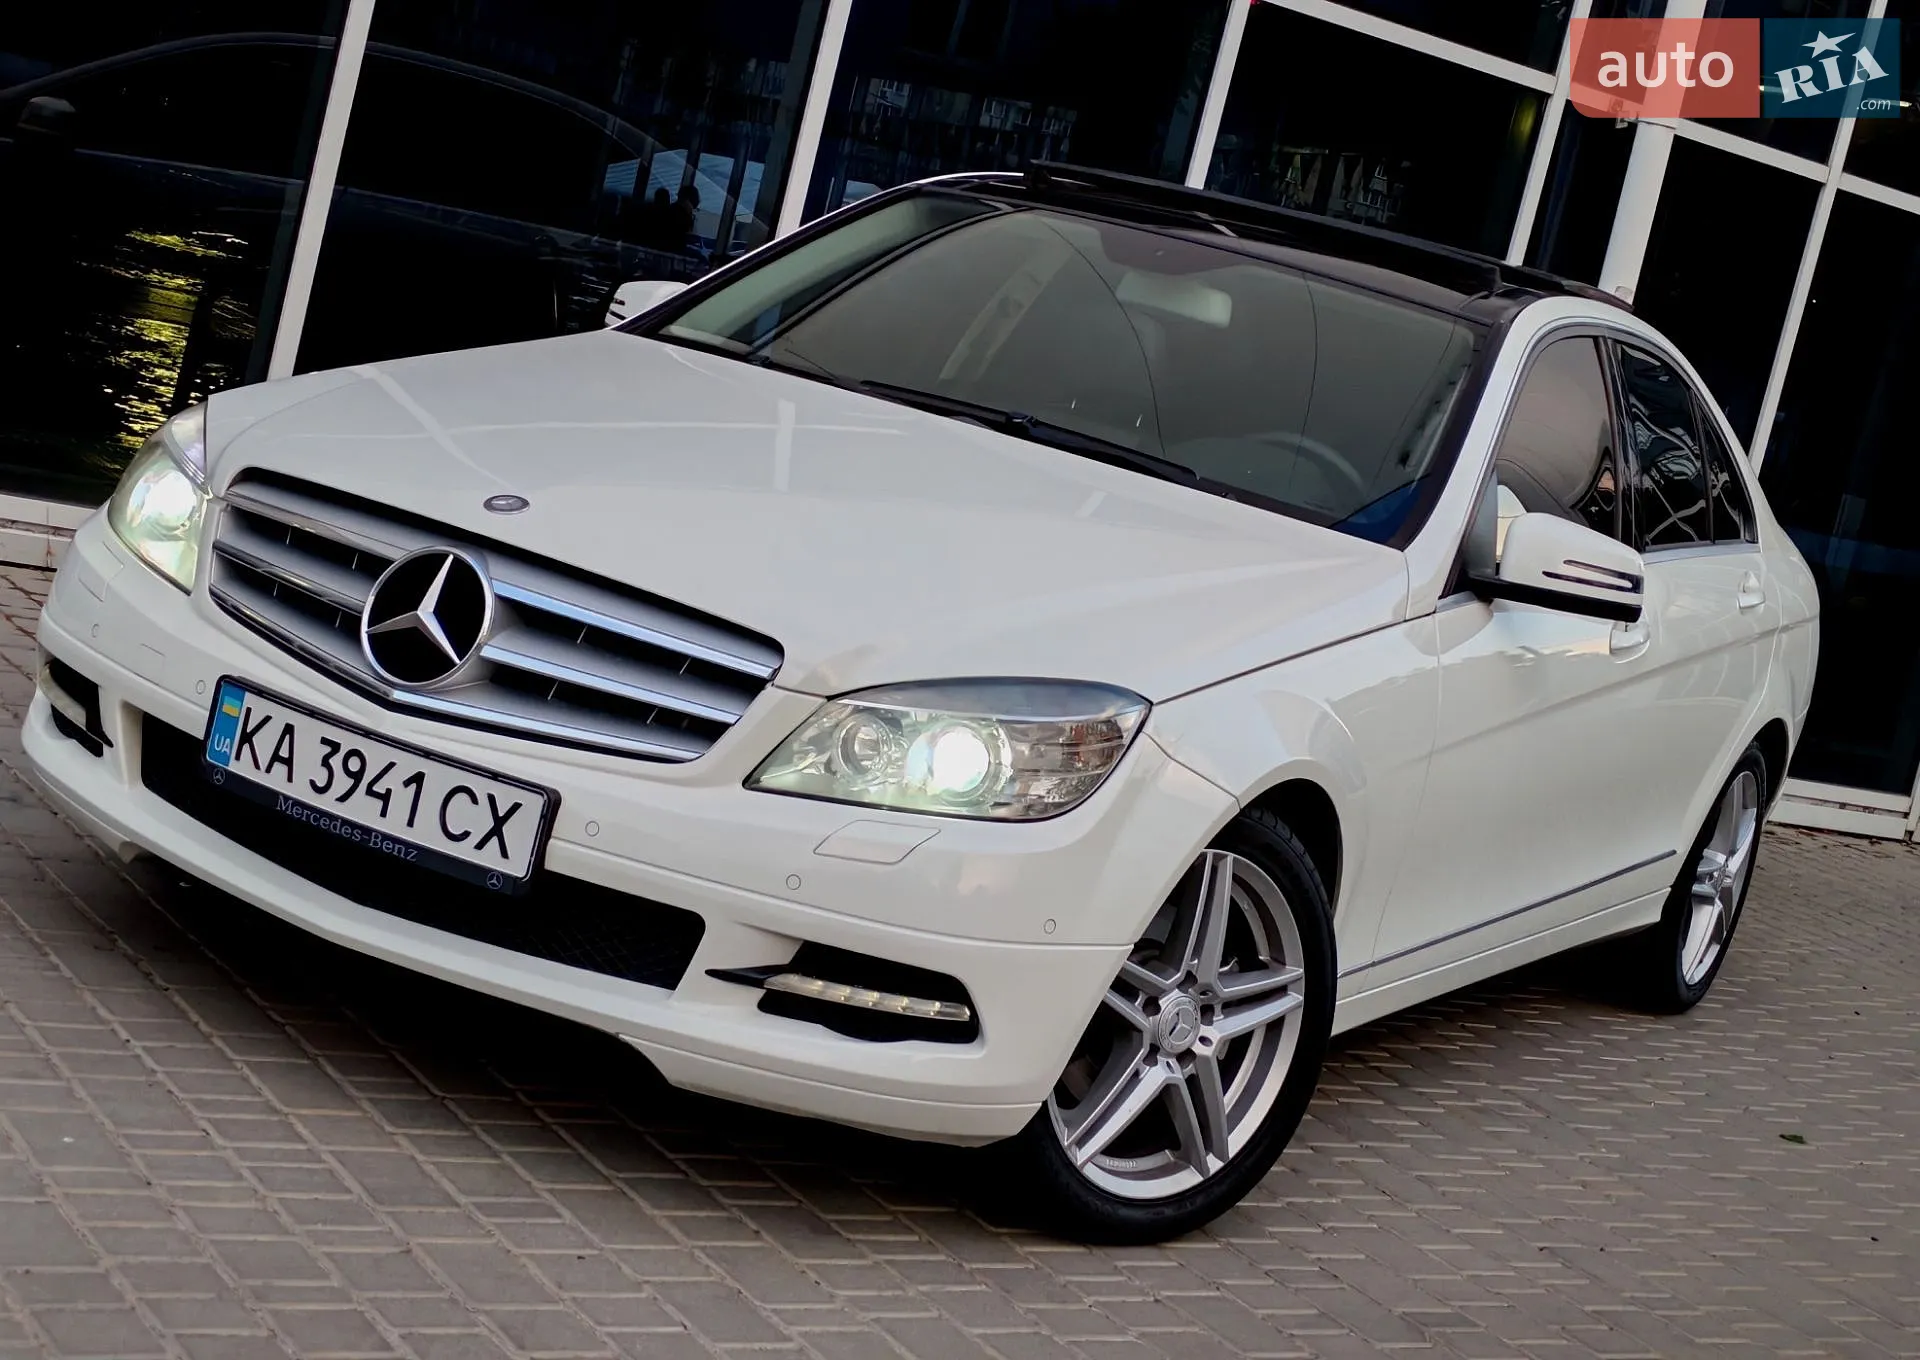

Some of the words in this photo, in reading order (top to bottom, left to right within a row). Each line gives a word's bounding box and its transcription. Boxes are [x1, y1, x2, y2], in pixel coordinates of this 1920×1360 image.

[214, 734, 232, 754] UA
[234, 706, 296, 783] KA
[309, 736, 426, 828] 3941
[439, 784, 523, 860] CX
[276, 795, 419, 862] Mercedes-Benz
